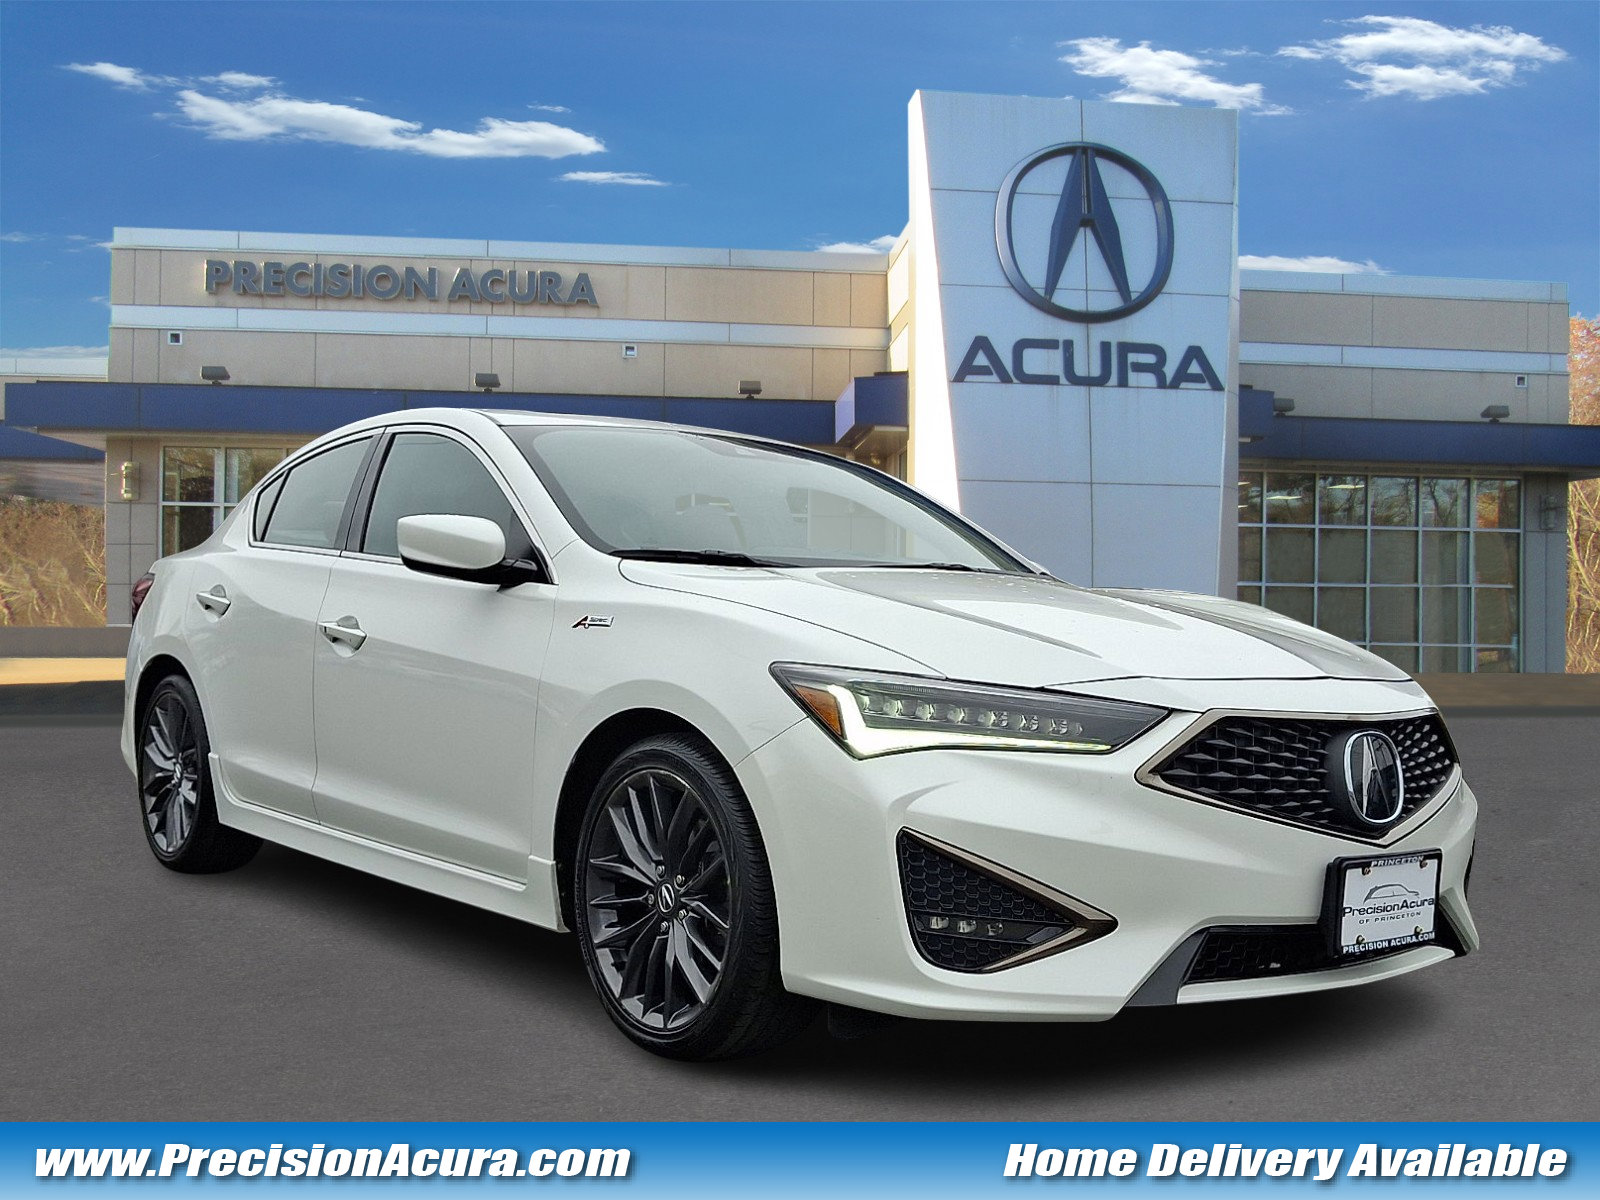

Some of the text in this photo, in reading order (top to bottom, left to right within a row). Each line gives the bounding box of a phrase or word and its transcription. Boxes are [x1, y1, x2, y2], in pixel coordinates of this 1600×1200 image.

[204, 259, 599, 307] PRECISION ACURA
[952, 335, 1225, 391] ACURA
[1372, 856, 1424, 867] PRINCETON
[1375, 911, 1421, 923] PRINCETON
[1343, 940, 1388, 954] PRECISION
